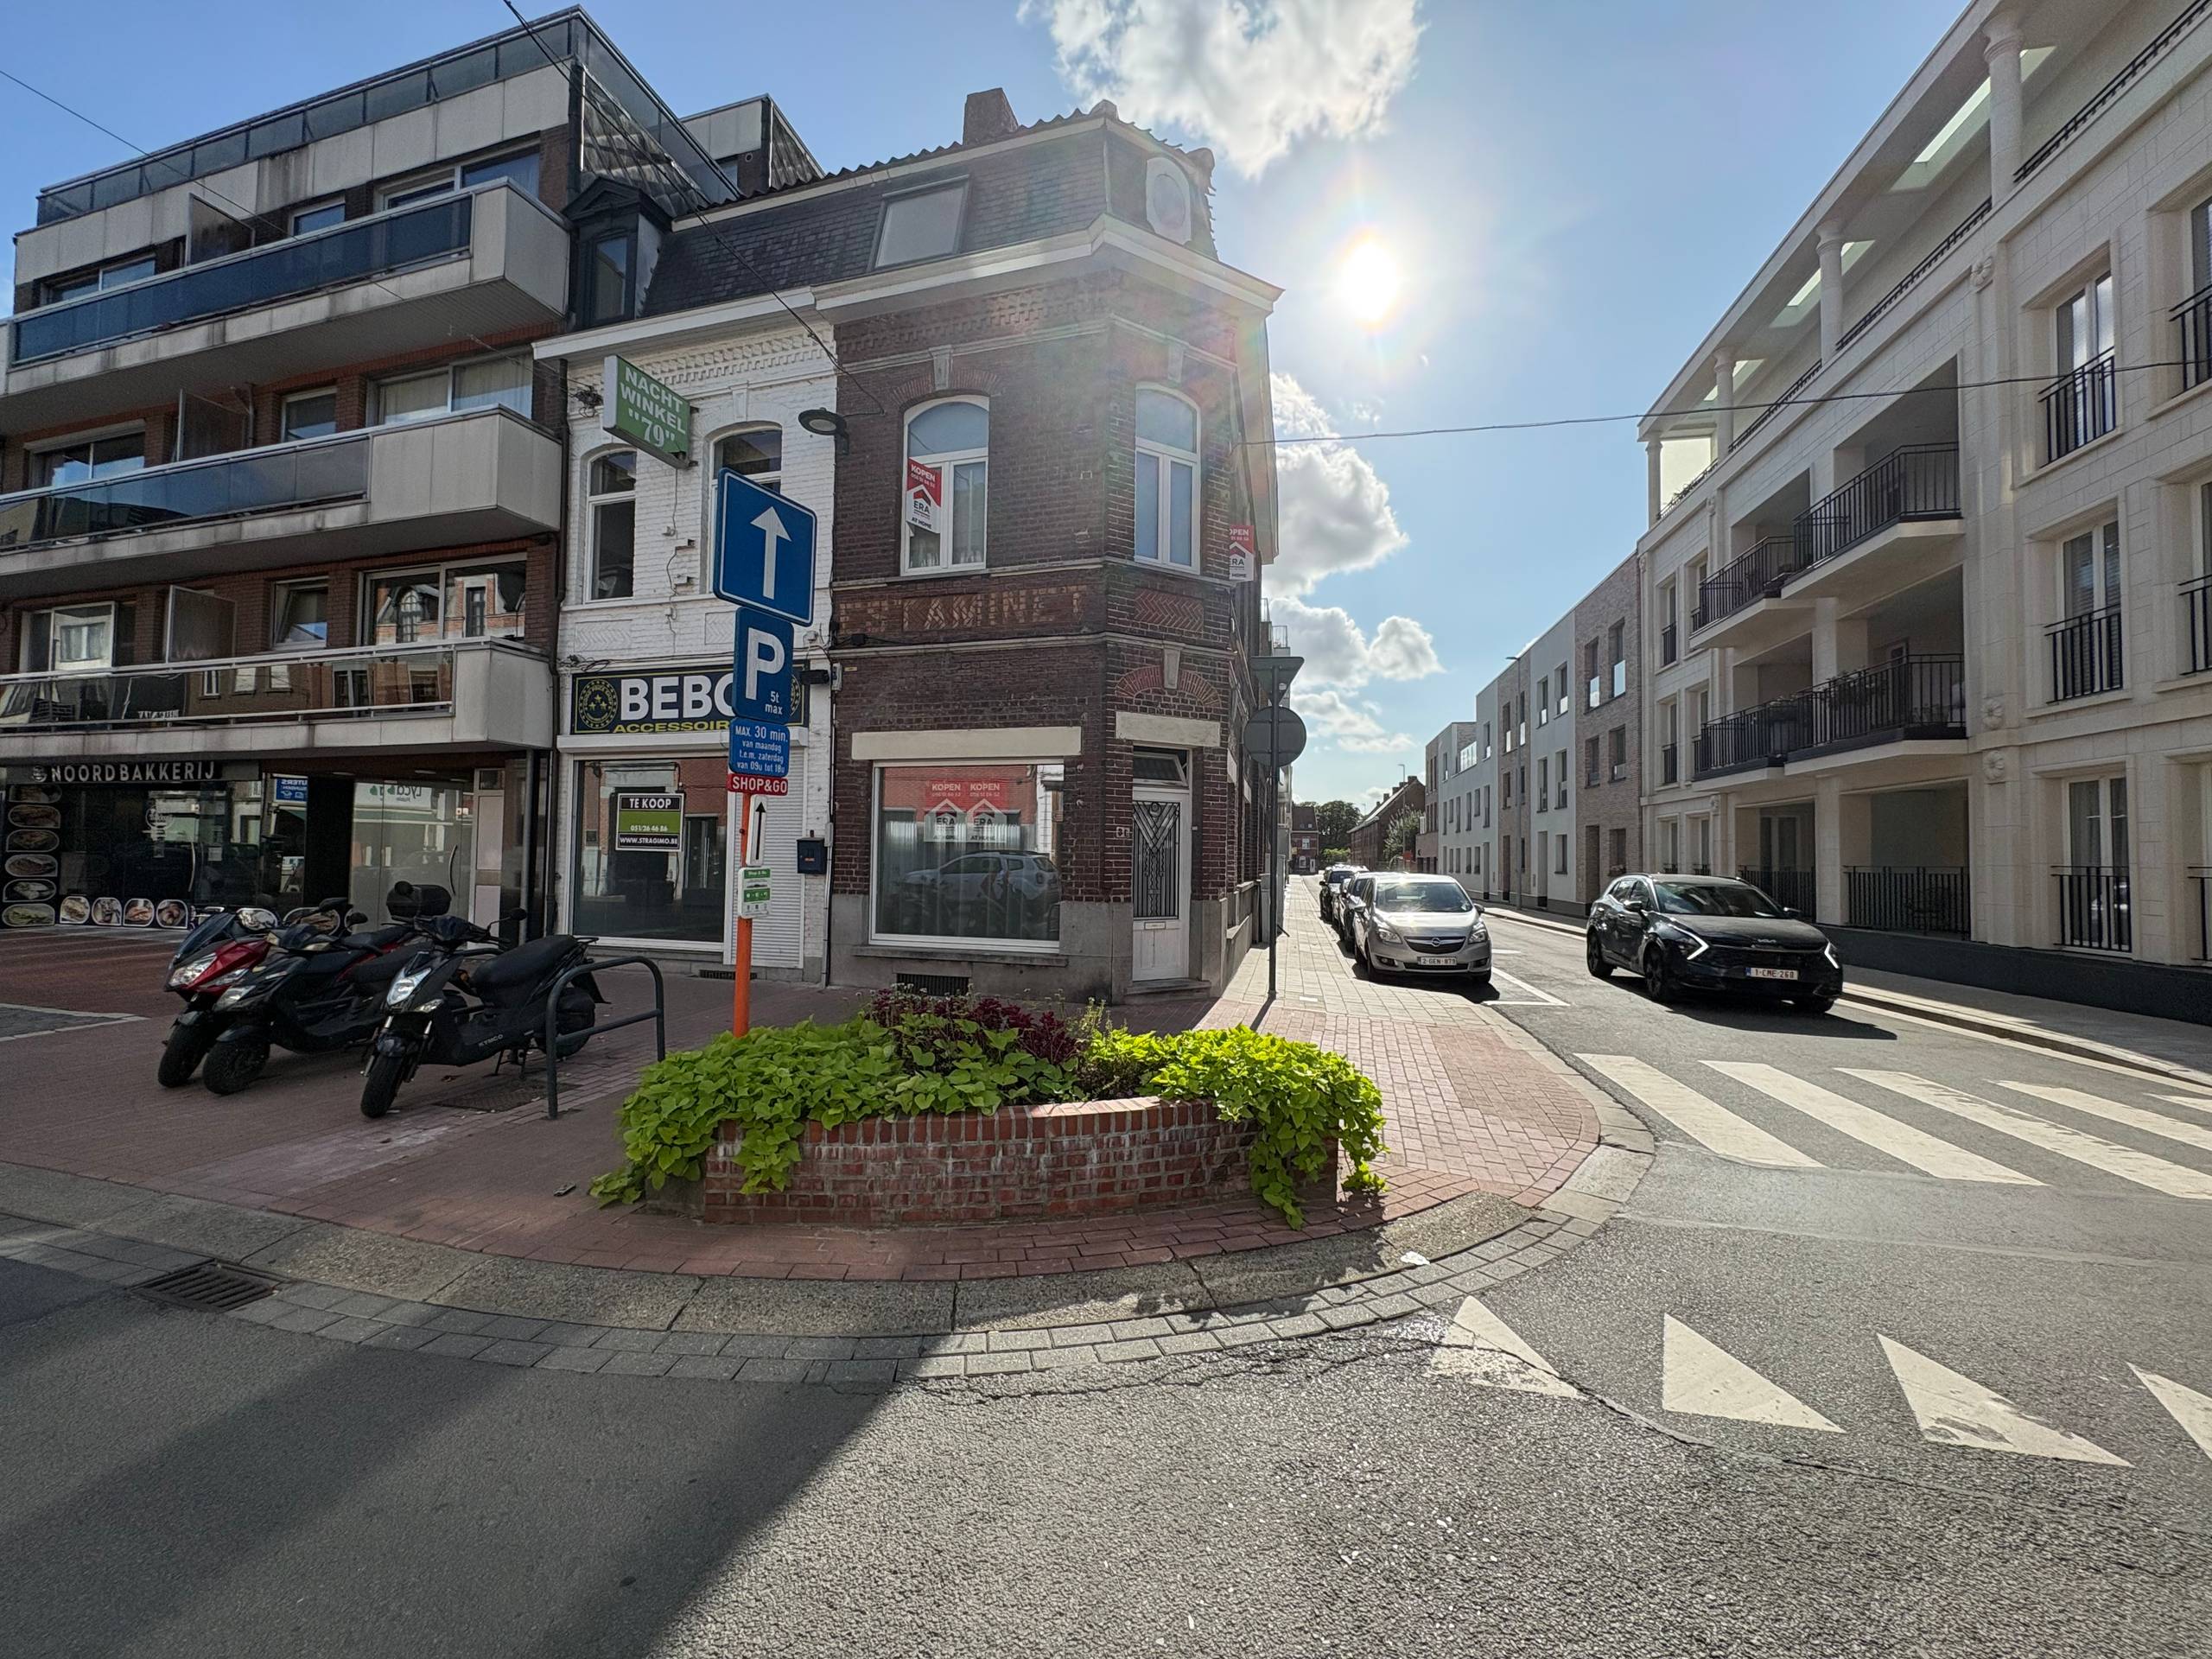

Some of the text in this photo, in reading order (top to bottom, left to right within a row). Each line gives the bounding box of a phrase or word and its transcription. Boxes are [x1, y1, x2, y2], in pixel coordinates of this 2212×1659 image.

[624, 365, 683, 413] NACHT
[619, 383, 685, 435] WINKEL
[911, 464, 936, 483] KOPEN
[913, 500, 931, 514] ERA
[918, 519, 932, 530] HOME
[745, 626, 785, 701] P
[770, 690, 780, 704] 5t
[765, 703, 784, 715] max
[754, 725, 767, 740] 30
[769, 728, 789, 742] min.
[741, 739, 782, 754] van maandag
[739, 749, 785, 765] t.e.m. zaterdag
[51, 761, 215, 782] NOORDBAKKERIJ
[736, 761, 748, 770] van
[750, 760, 763, 772] 09u
[764, 763, 773, 772] tot
[732, 776, 788, 793] SHOP&GO
[931, 783, 961, 791] KOPEN
[969, 783, 1000, 791] KOPEN
[629, 798, 671, 809] TE KOOP
[936, 817, 955, 826] ERA
[973, 817, 993, 827] ERA
